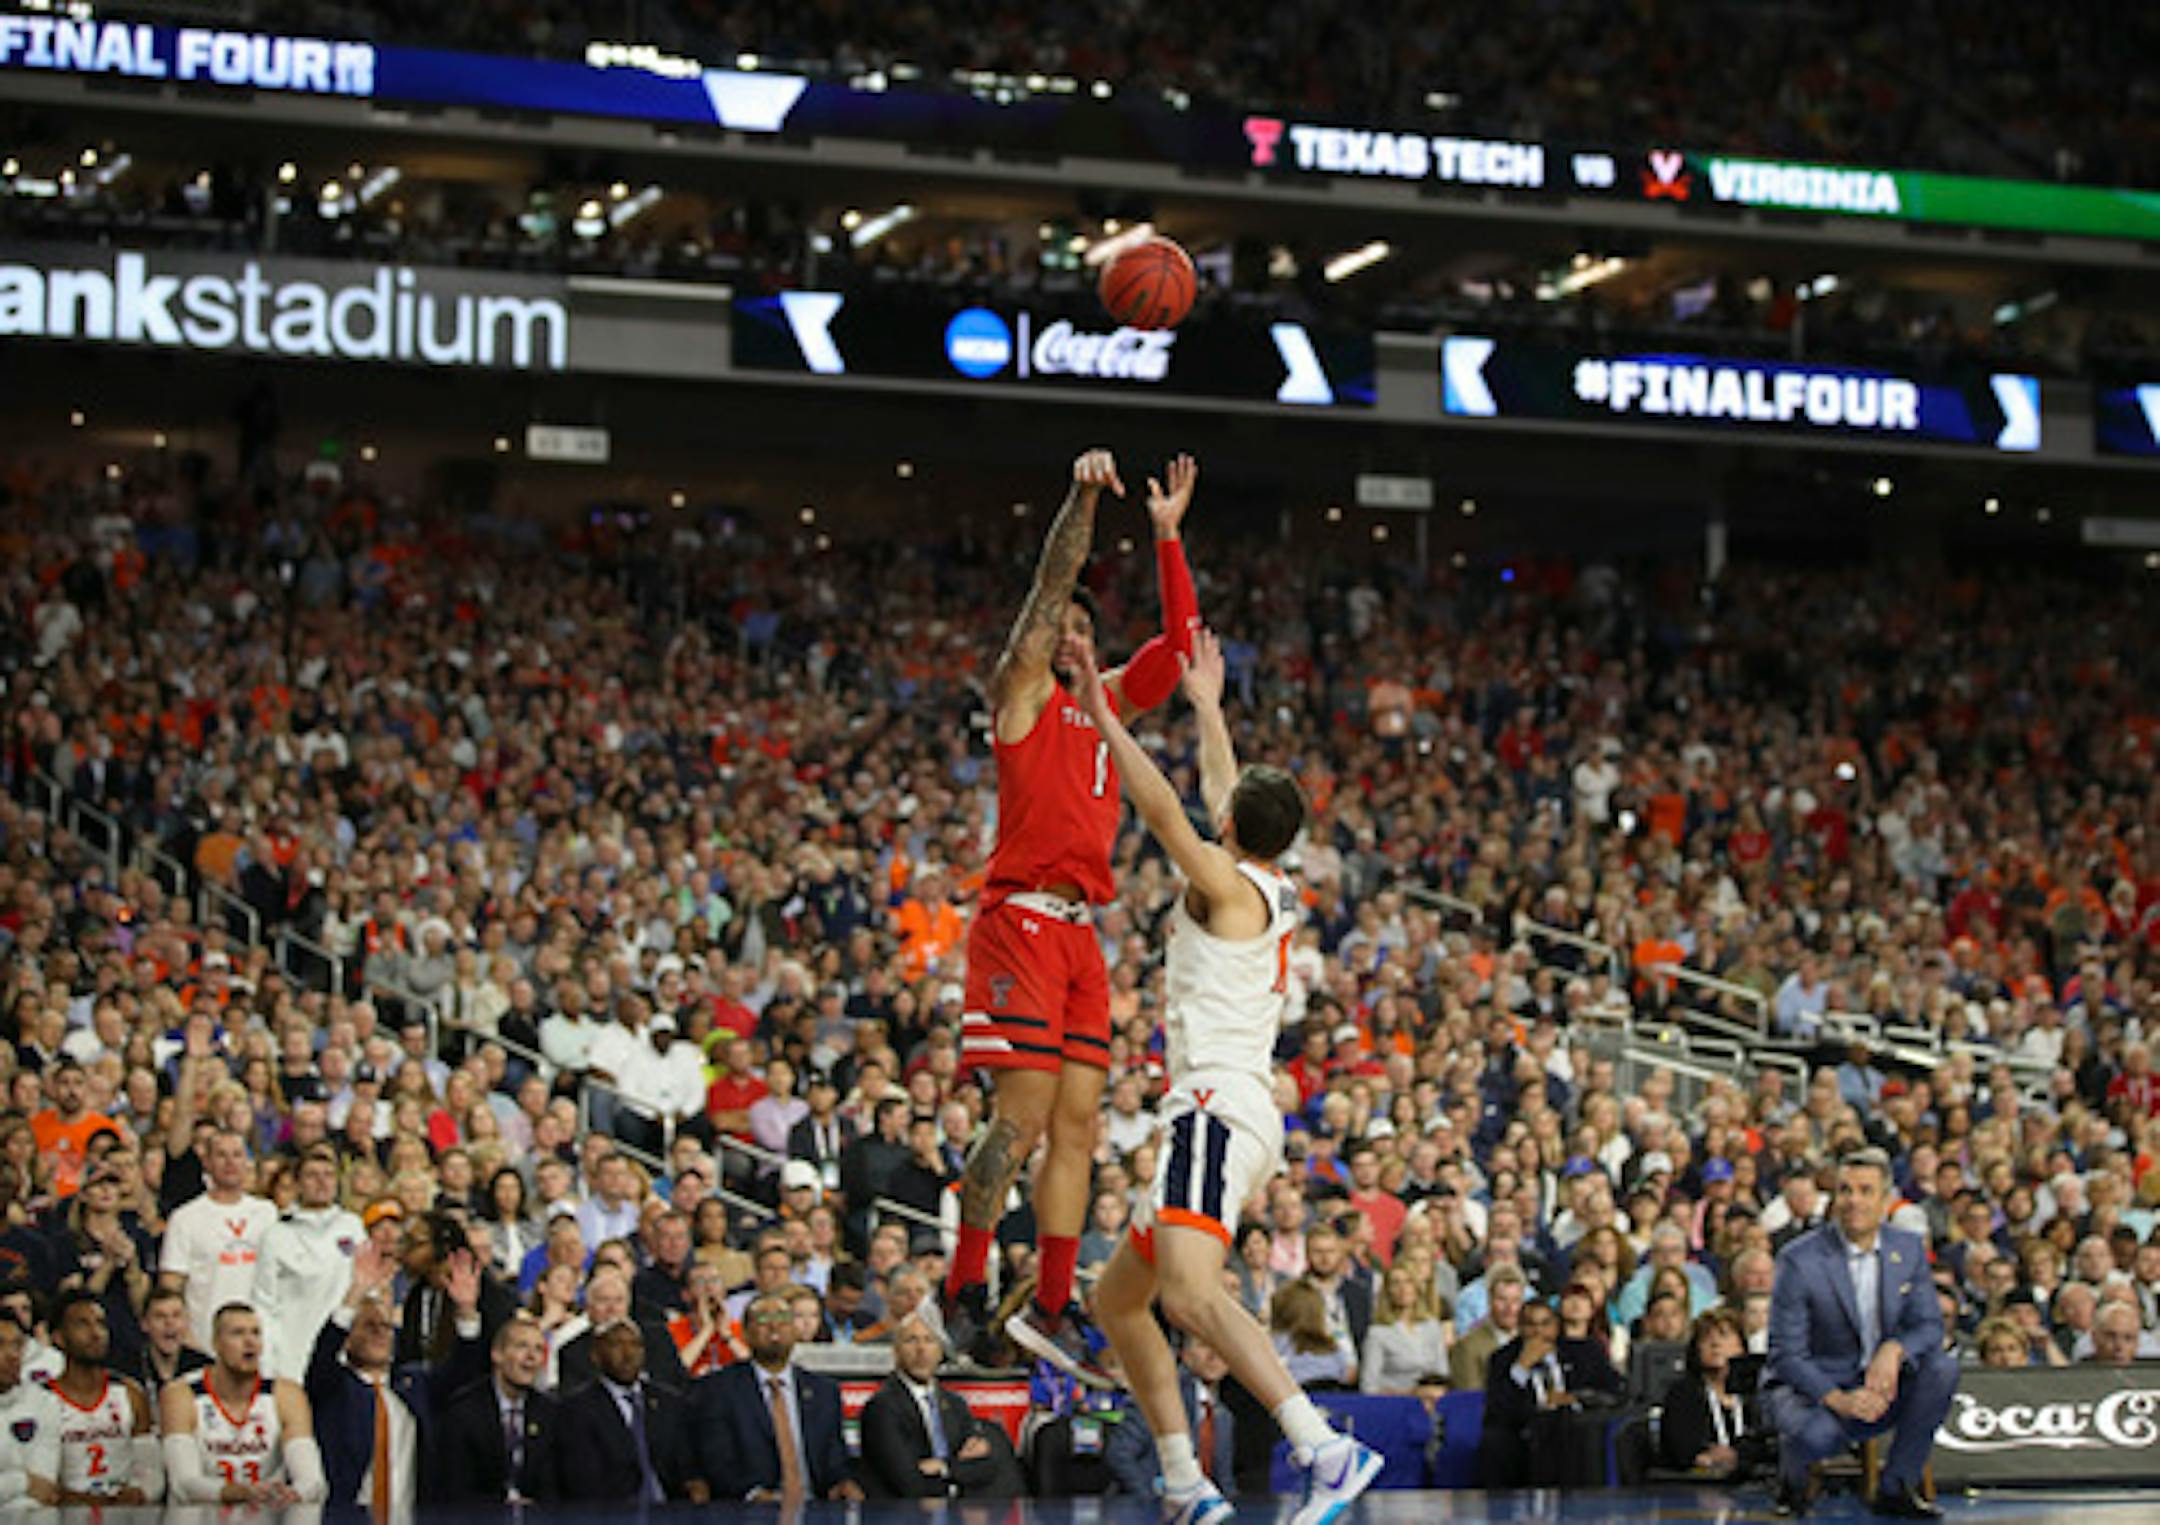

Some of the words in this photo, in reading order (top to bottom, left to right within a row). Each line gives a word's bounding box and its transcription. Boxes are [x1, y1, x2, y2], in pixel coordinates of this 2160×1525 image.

[0, 14, 167, 78] FINAL
[177, 28, 333, 91] FOUR
[1289, 123, 1428, 180] TEXAS
[1432, 136, 1544, 188] TECH
[1709, 159, 1900, 214] VIRGINIA
[1574, 358, 1920, 430] #FINALFOUR
[1092, 740, 1109, 797] 1
[86, 1443, 108, 1477] 2
